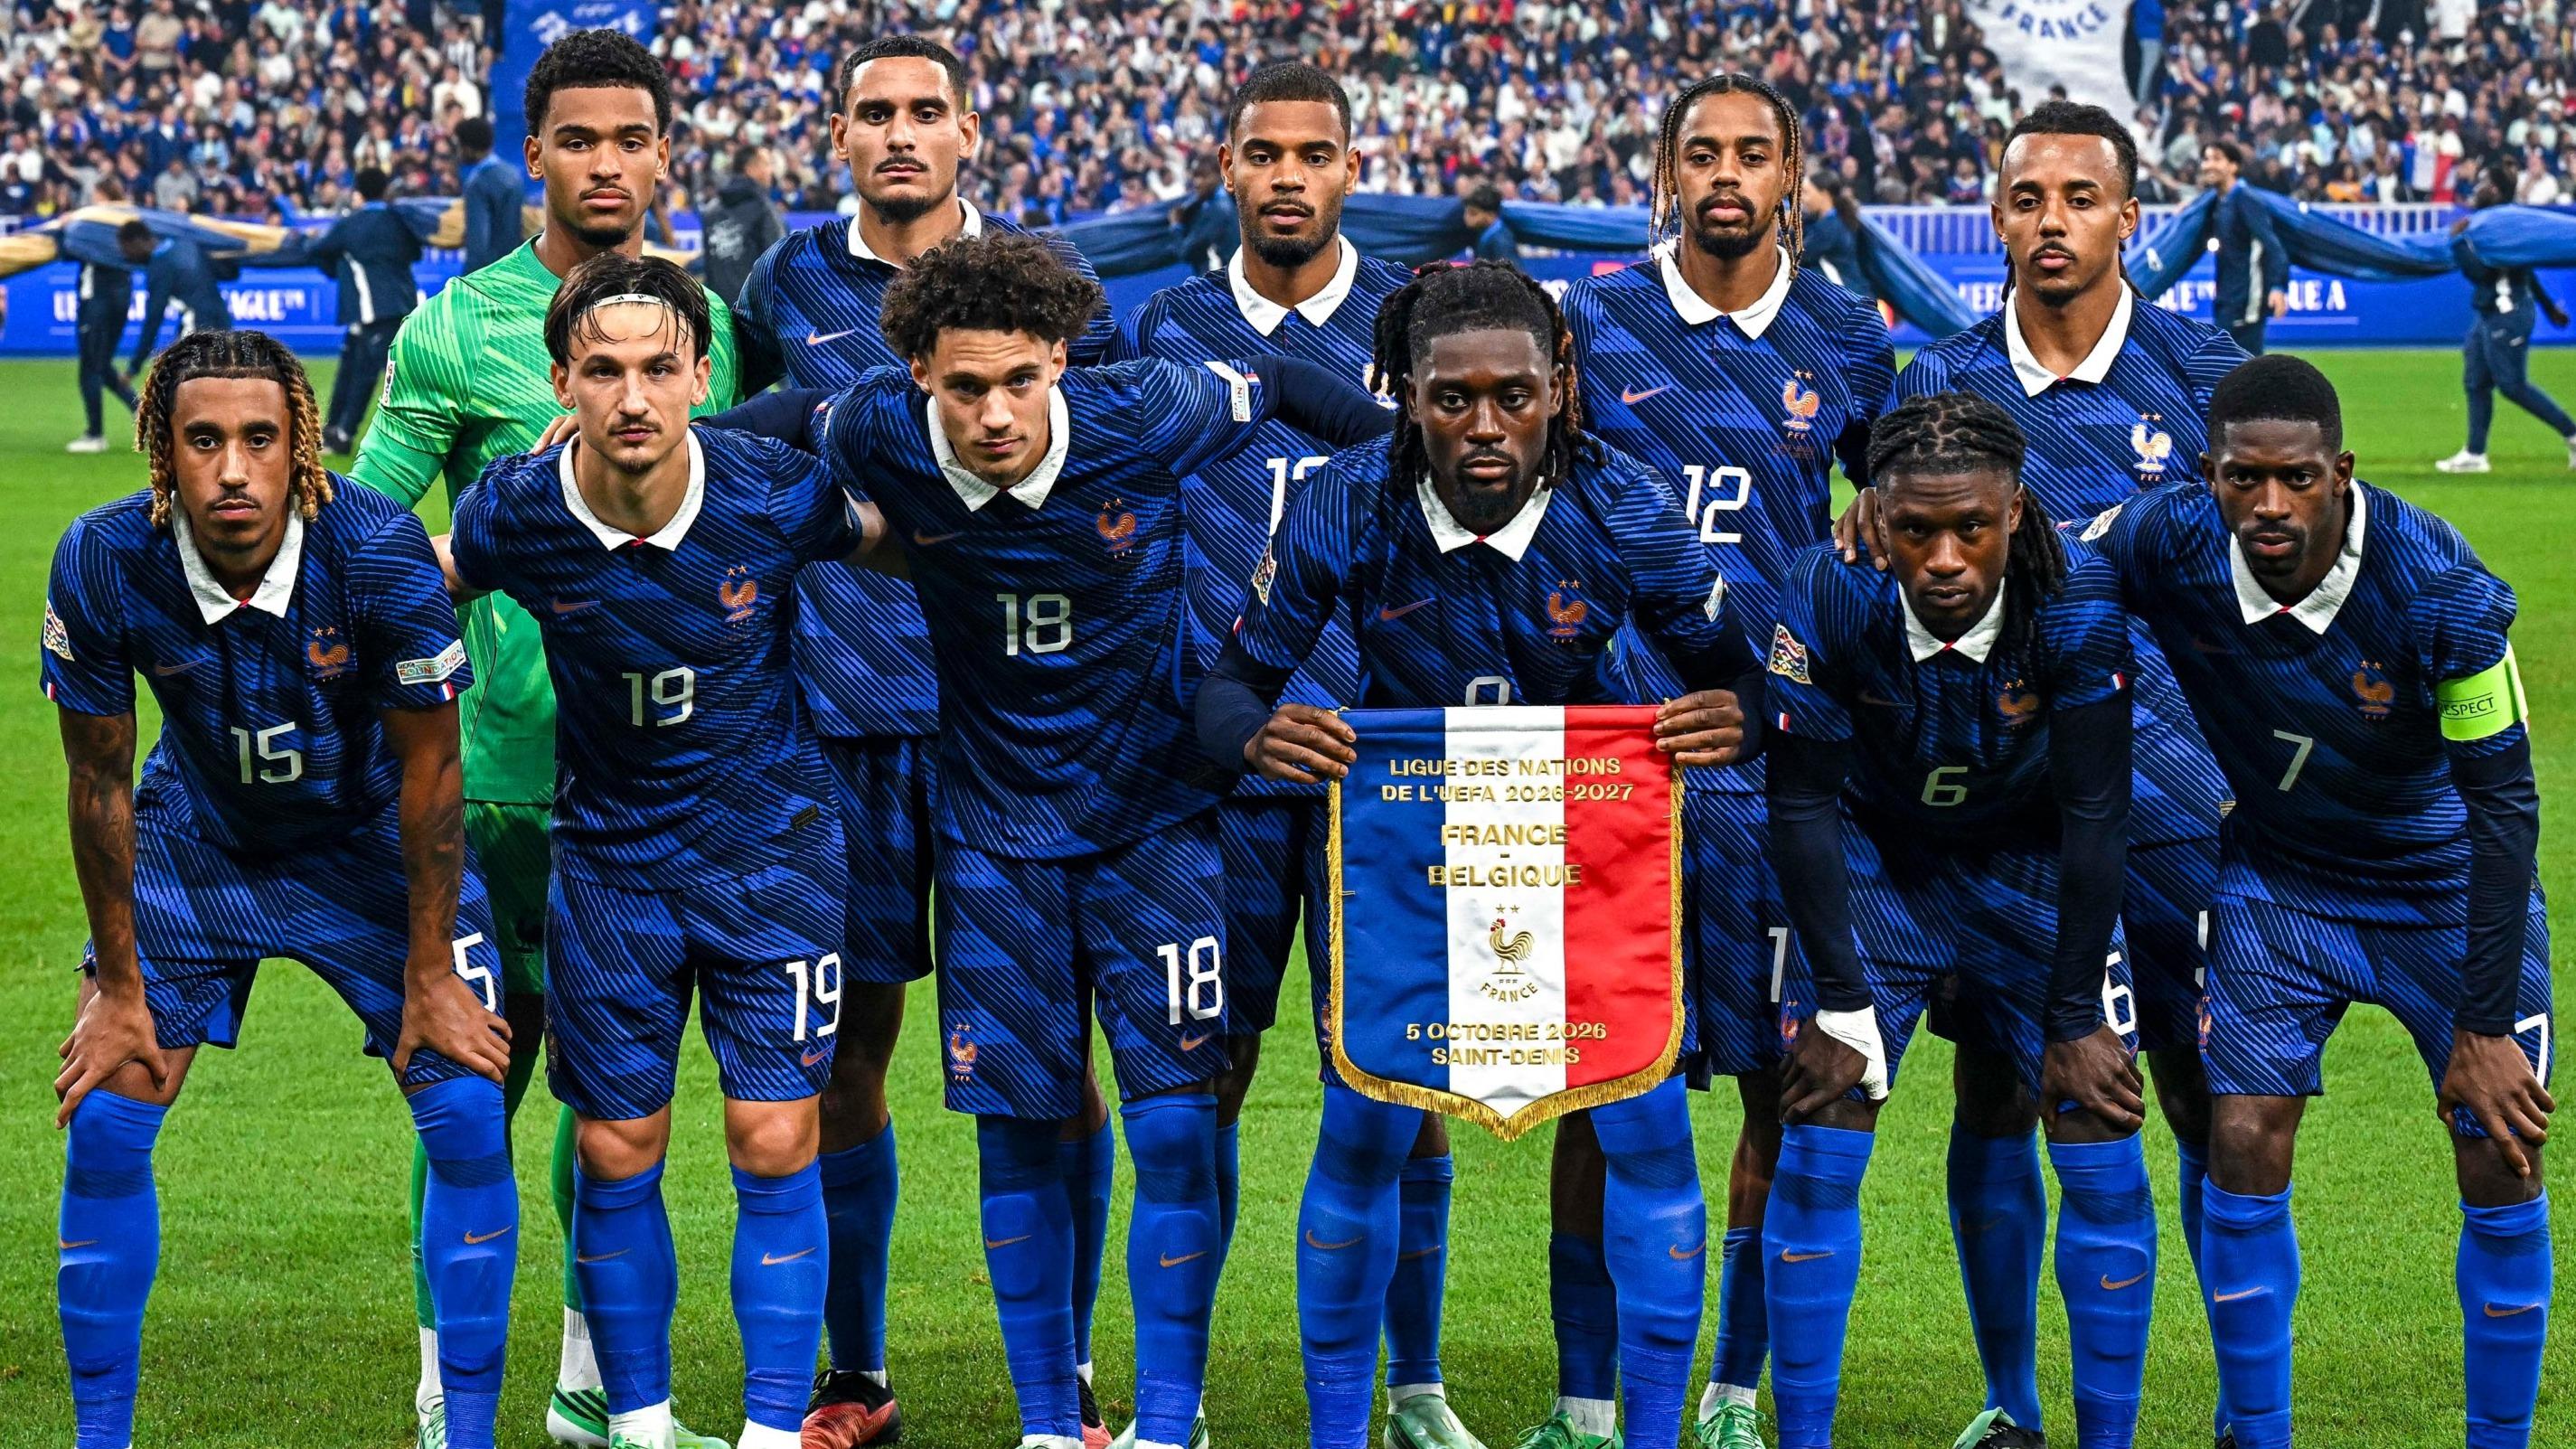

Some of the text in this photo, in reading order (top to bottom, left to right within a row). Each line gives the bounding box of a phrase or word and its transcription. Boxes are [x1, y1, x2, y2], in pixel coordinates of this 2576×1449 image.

[2000, 3, 2108, 39] FRANCE
[1788, 430, 1807, 440] FFF
[2140, 474, 2161, 482] FFF
[1683, 464, 1752, 544] 12
[996, 594, 1072, 656] 18
[622, 666, 694, 727] 19
[231, 721, 303, 784] 15
[1389, 757, 1621, 776] LIGUE DES NATIONS
[2273, 729, 2313, 792] 7
[1381, 784, 1634, 802] DE L'UEFA 2026-2027
[1921, 767, 1969, 806] 6
[1441, 823, 1569, 846] FRANCE
[1427, 864, 1583, 888] BELGIQUE
[452, 932, 495, 1012] 5
[1156, 935, 1225, 1025] 18
[1769, 927, 1788, 1002] 1
[785, 952, 841, 1043] 19
[1480, 982, 1538, 1002] FRANCE
[2101, 951, 2137, 1037] 6
[1406, 1022, 1607, 1040] 5 OCTOBRE 2026
[1432, 1047, 1580, 1065] SAINT-DENIS
[2515, 1012, 2549, 1088] 7
